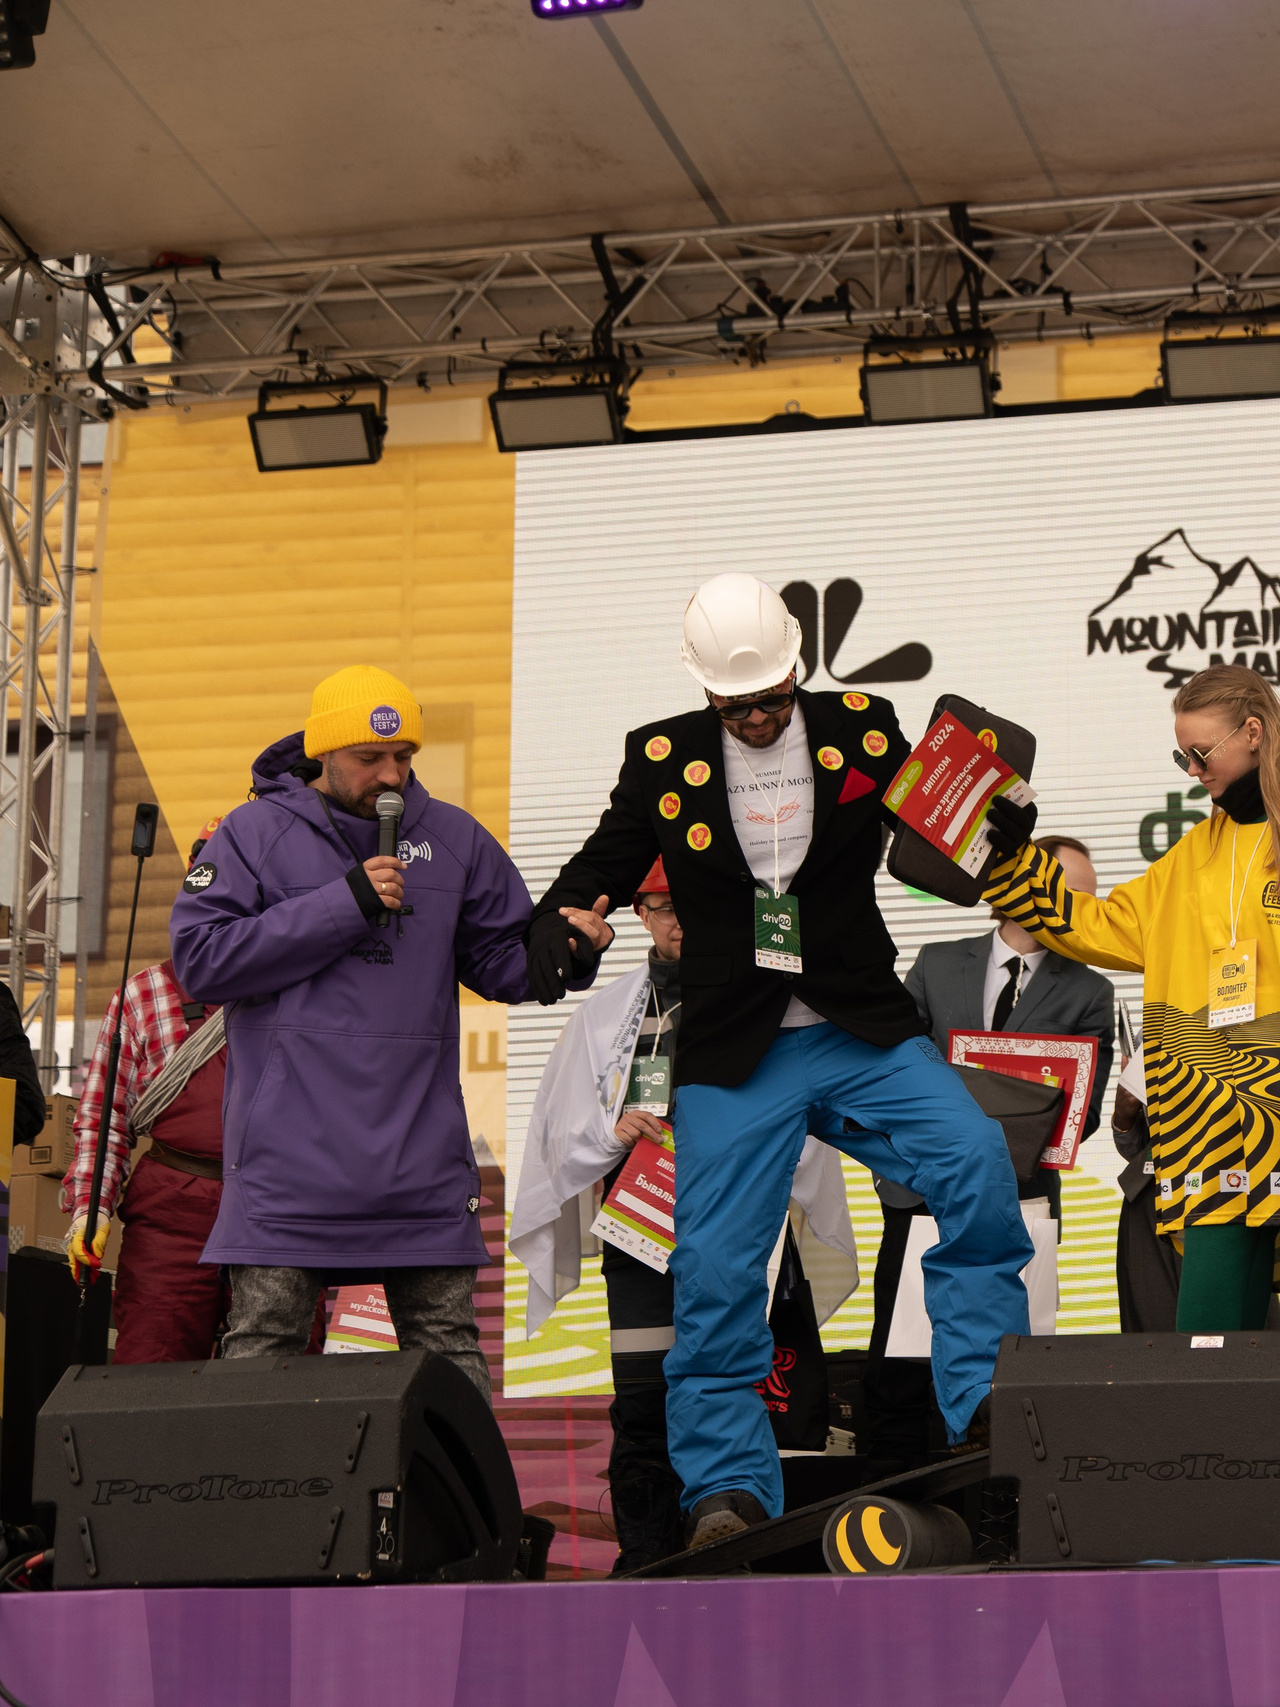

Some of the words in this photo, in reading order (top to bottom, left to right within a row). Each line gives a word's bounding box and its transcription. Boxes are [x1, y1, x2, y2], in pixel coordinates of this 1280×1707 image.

[372, 712, 398, 722] GRELKA
[373, 721, 391, 731] FEST
[928, 722, 956, 753] 2024
[727, 784, 746, 794] AZY
[787, 776, 813, 787] MOO
[921, 755, 953, 797] ДИПЛОМ
[923, 803, 944, 829] Приз
[940, 752, 982, 808] зрительских
[942, 774, 975, 818] симпатий
[762, 912, 792, 931] drivee
[771, 933, 784, 944] 40
[1217, 982, 1248, 997] ВОЛОНТЕР
[635, 1072, 666, 1085] drivee
[644, 1088, 651, 1097] 2
[635, 1173, 677, 1206] Бывалы
[350, 1302, 388, 1316] мужской
[92, 1474, 334, 1506] ProTone
[380, 1517, 387, 1535] 4
